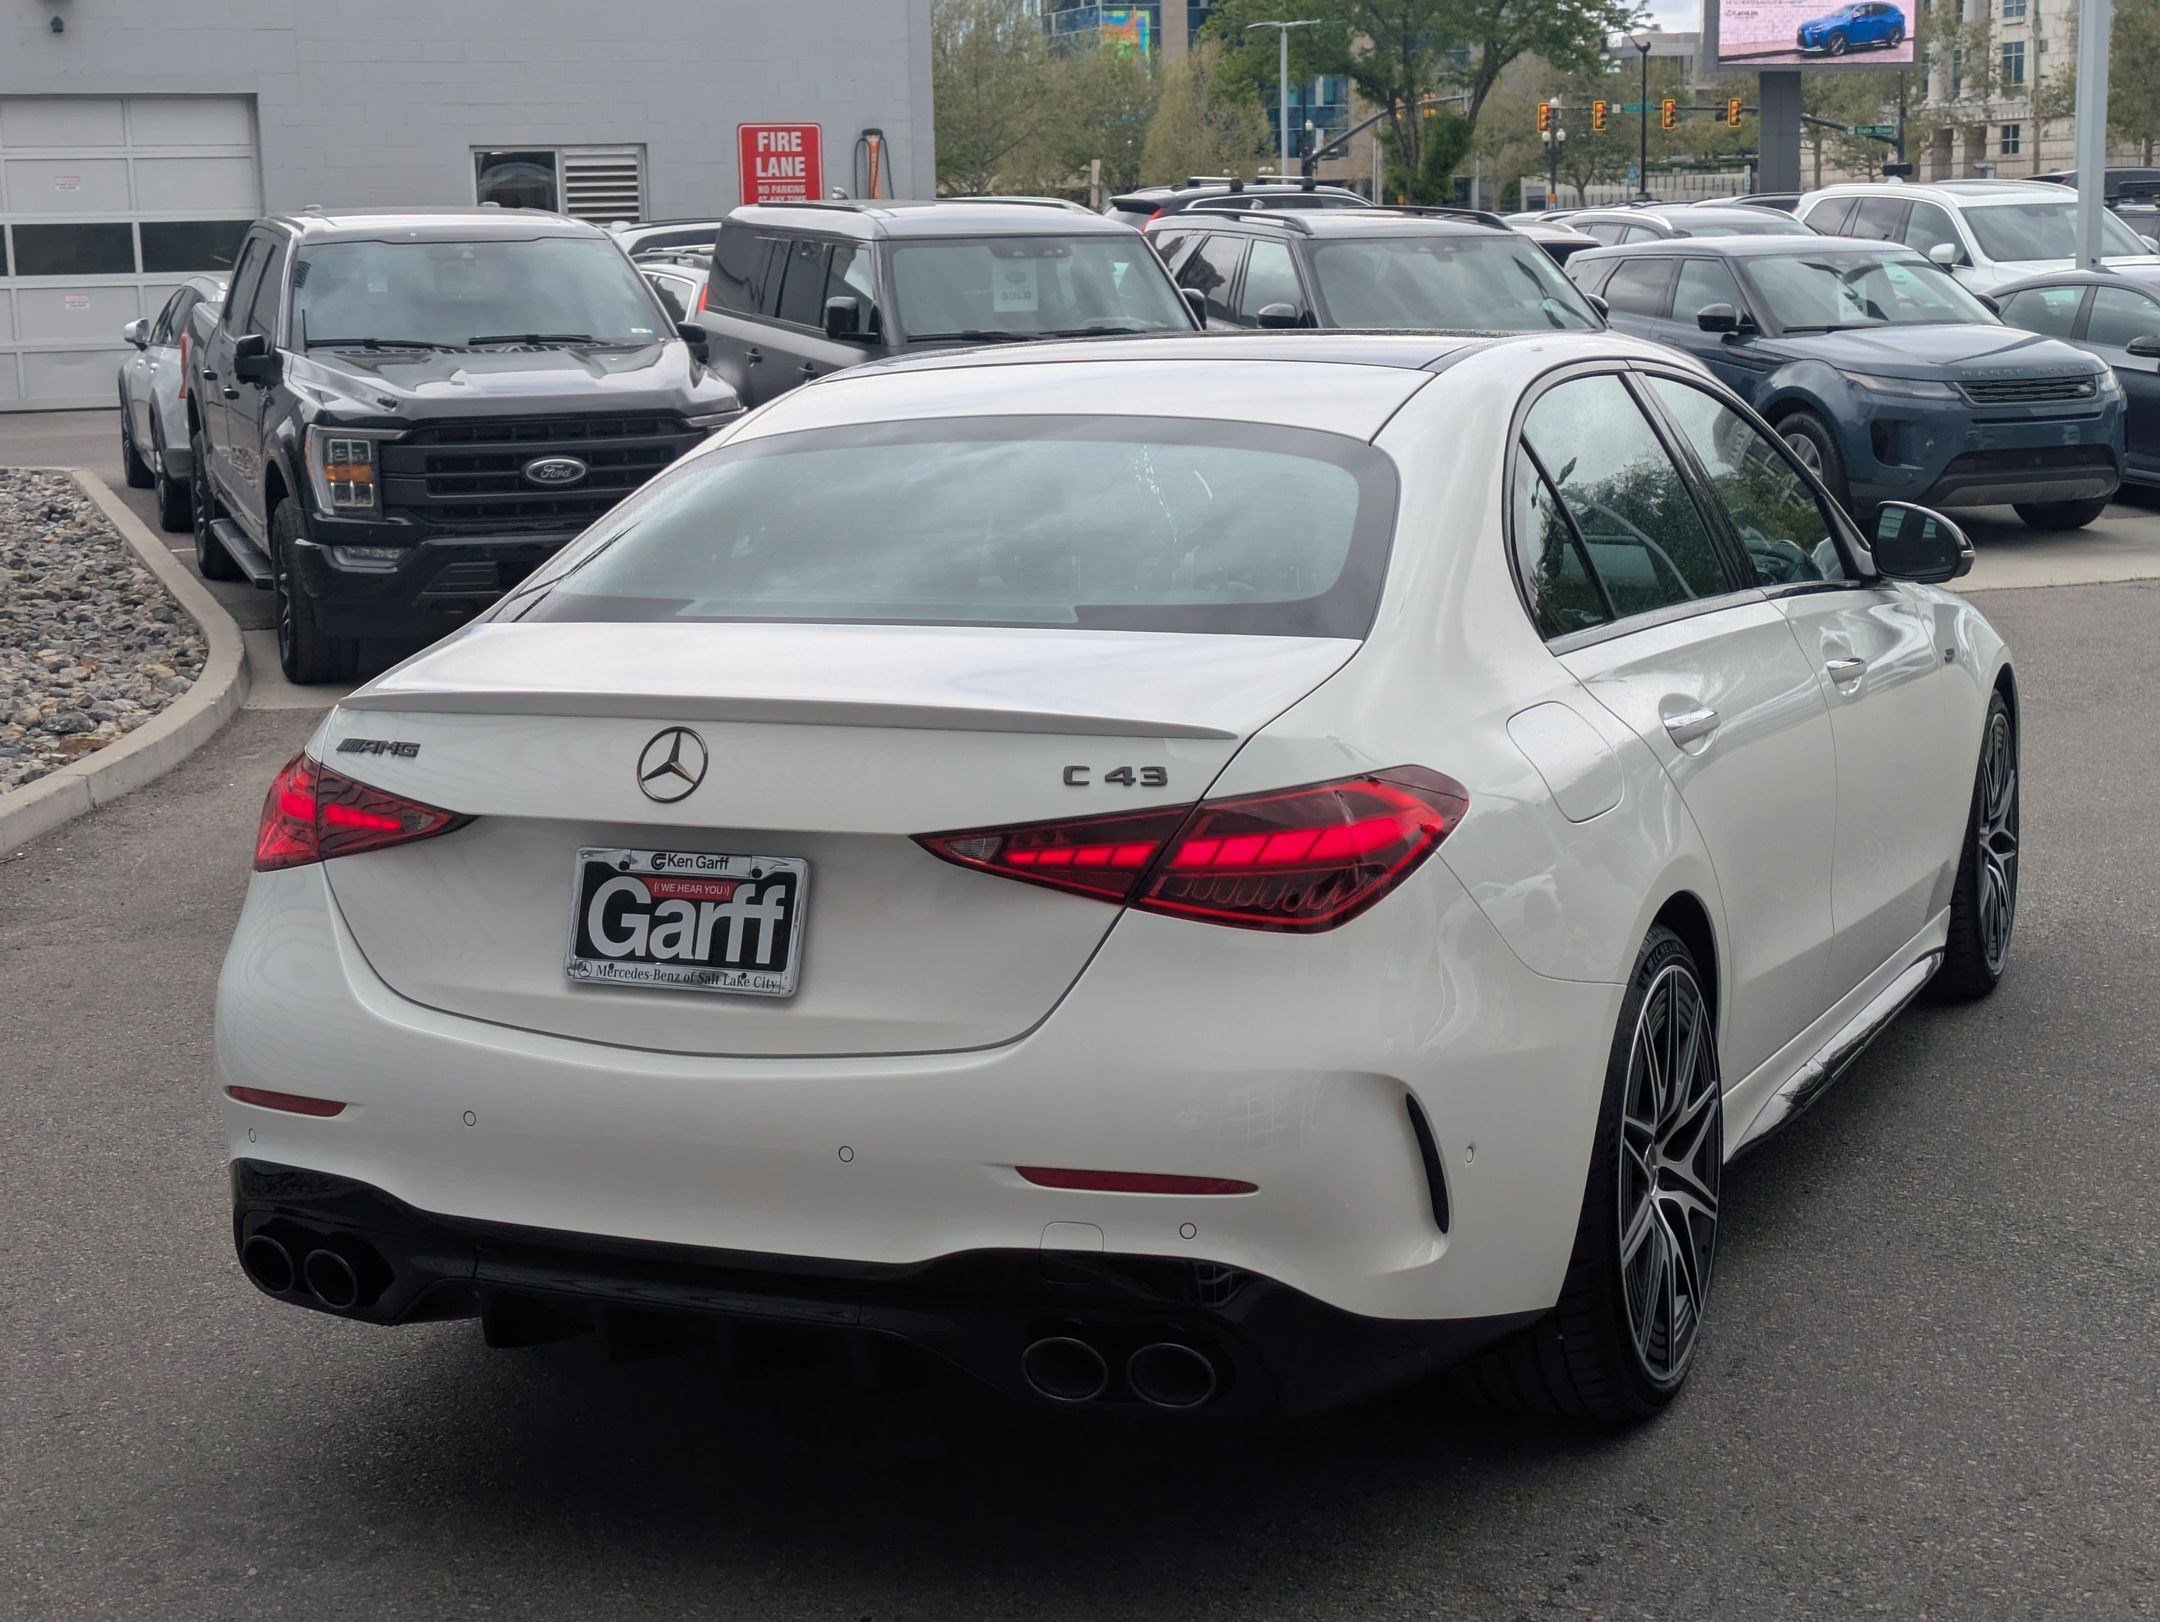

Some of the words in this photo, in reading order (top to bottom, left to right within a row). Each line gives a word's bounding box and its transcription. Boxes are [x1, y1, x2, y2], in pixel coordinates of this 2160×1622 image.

[757, 131, 803, 152] FIRE
[755, 156, 806, 177] LANE
[758, 185, 770, 194] NO
[771, 185, 806, 194] PARKING
[1961, 368, 2023, 377] RANGE
[541, 464, 573, 479] Ford
[359, 738, 421, 758] AMG
[1063, 765, 1090, 786] C
[1104, 765, 1168, 787] 43
[667, 854, 694, 868] Ken
[696, 855, 730, 870] Garff
[661, 883, 677, 893] WE
[677, 884, 702, 894] HEAR
[704, 885, 724, 895] YOU
[587, 875, 786, 965] Garff
[595, 963, 681, 982] Mercedes-Benz
[683, 970, 695, 984] of
[698, 972, 720, 985] Salt
[723, 973, 751, 988] Lake
[753, 976, 780, 992] City
